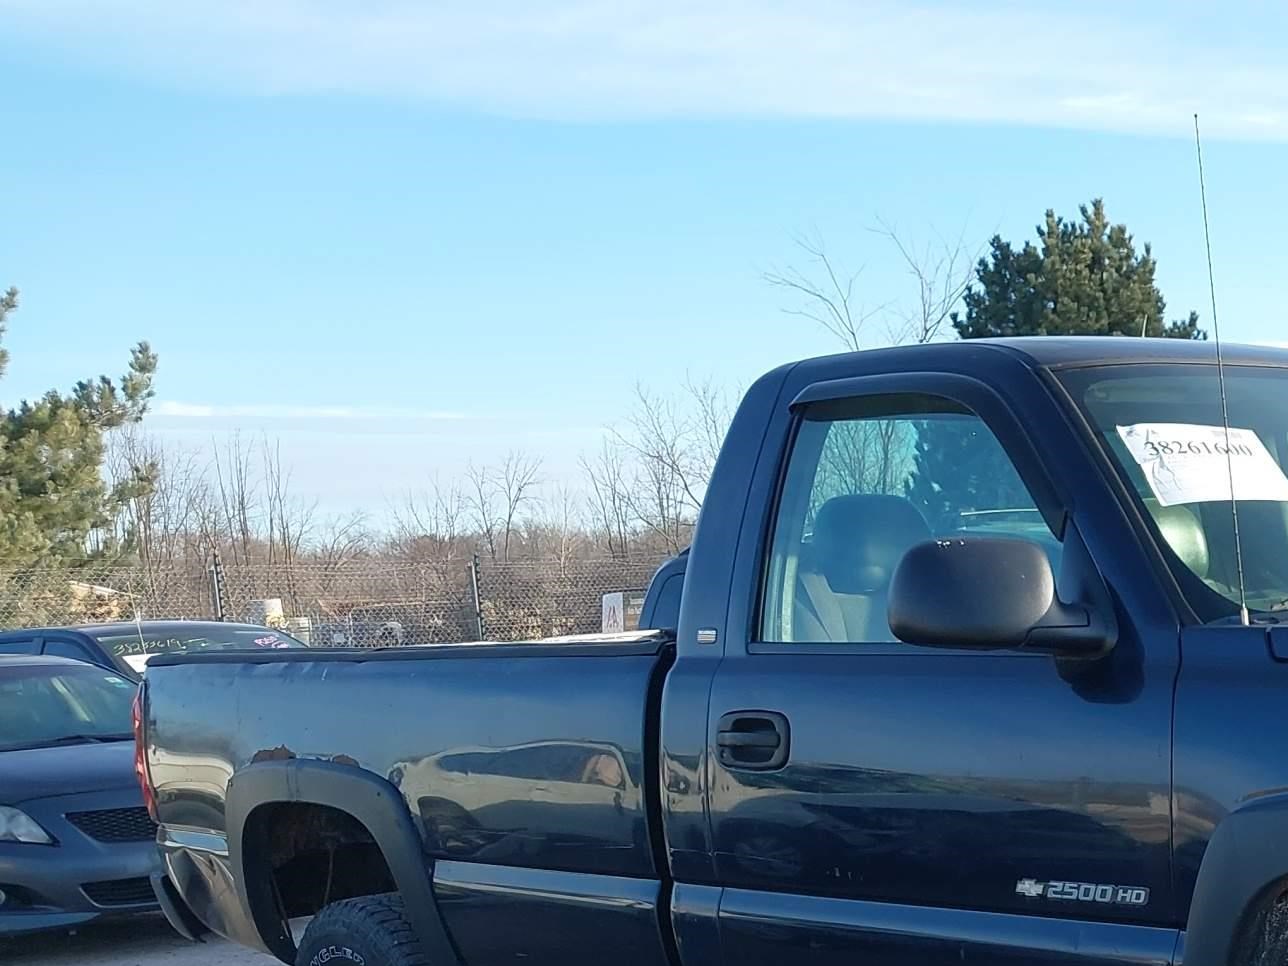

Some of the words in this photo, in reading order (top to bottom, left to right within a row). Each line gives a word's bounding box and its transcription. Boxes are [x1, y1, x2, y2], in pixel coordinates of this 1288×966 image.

[1144, 440, 1253, 457] 38261600
[1047, 882, 1112, 903] 2500
[1117, 888, 1146, 903] HD
